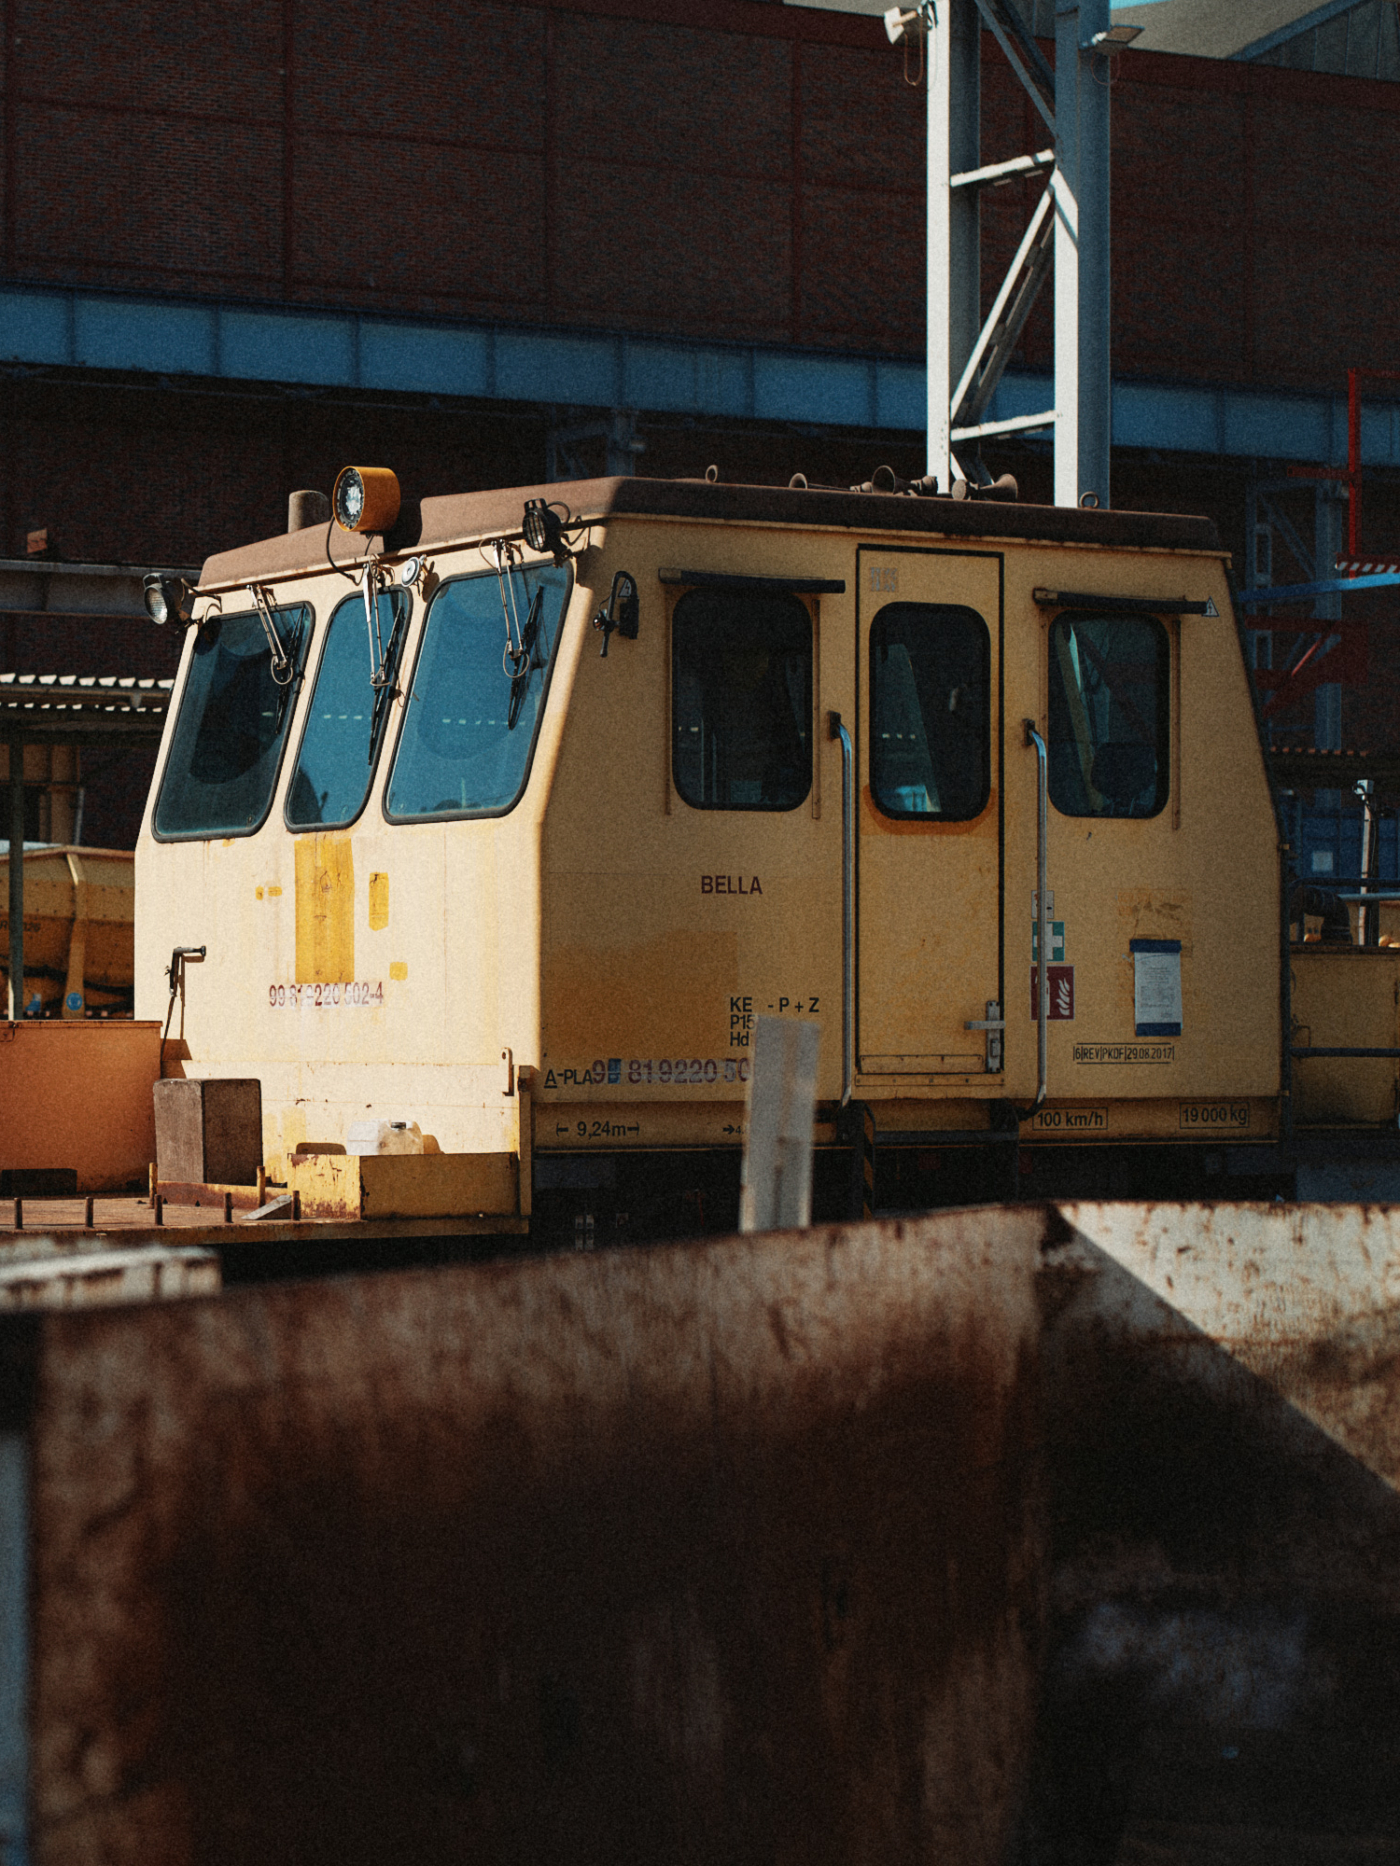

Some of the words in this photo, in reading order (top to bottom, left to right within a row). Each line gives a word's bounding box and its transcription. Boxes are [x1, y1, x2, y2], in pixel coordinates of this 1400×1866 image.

[701, 875, 763, 894] BELLA
[269, 984, 286, 1007] 99
[730, 997, 752, 1012] KE
[779, 997, 790, 1012] P
[808, 997, 820, 1012] Z
[730, 1031, 749, 1046] Hd
[1037, 1112, 1061, 1126] 100
[1066, 1111, 1103, 1126] km/h
[1230, 1105, 1247, 1125] kg
